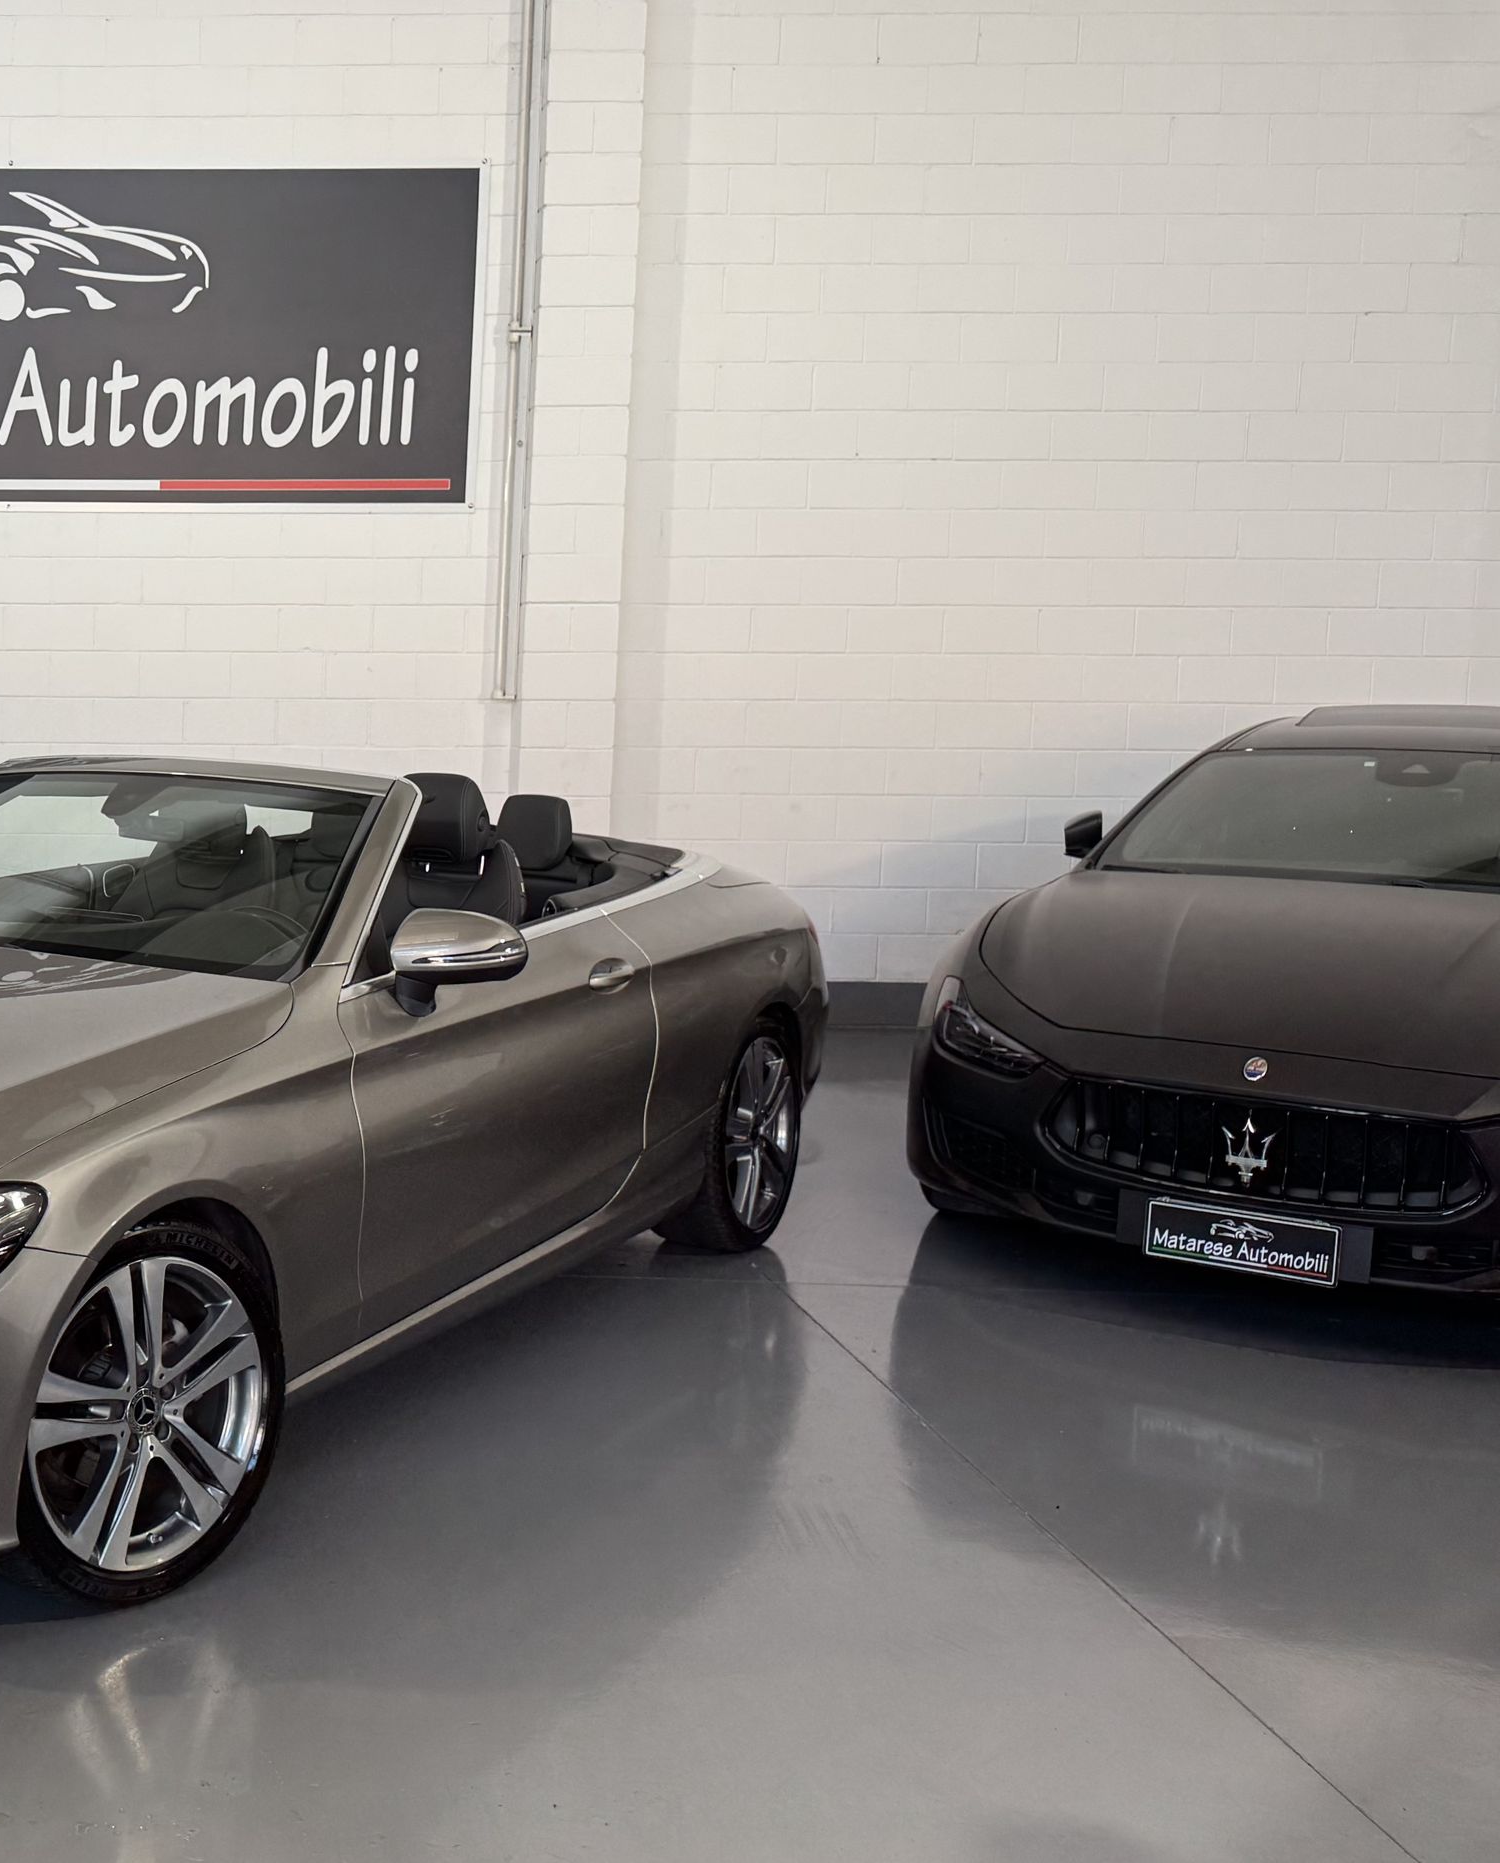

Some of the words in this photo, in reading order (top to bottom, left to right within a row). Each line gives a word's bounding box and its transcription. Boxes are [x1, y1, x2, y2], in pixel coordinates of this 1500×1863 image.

[166, 1232, 238, 1269] MICHELIN
[1153, 1227, 1233, 1258] Matarese
[1236, 1241, 1330, 1274] Automobili
